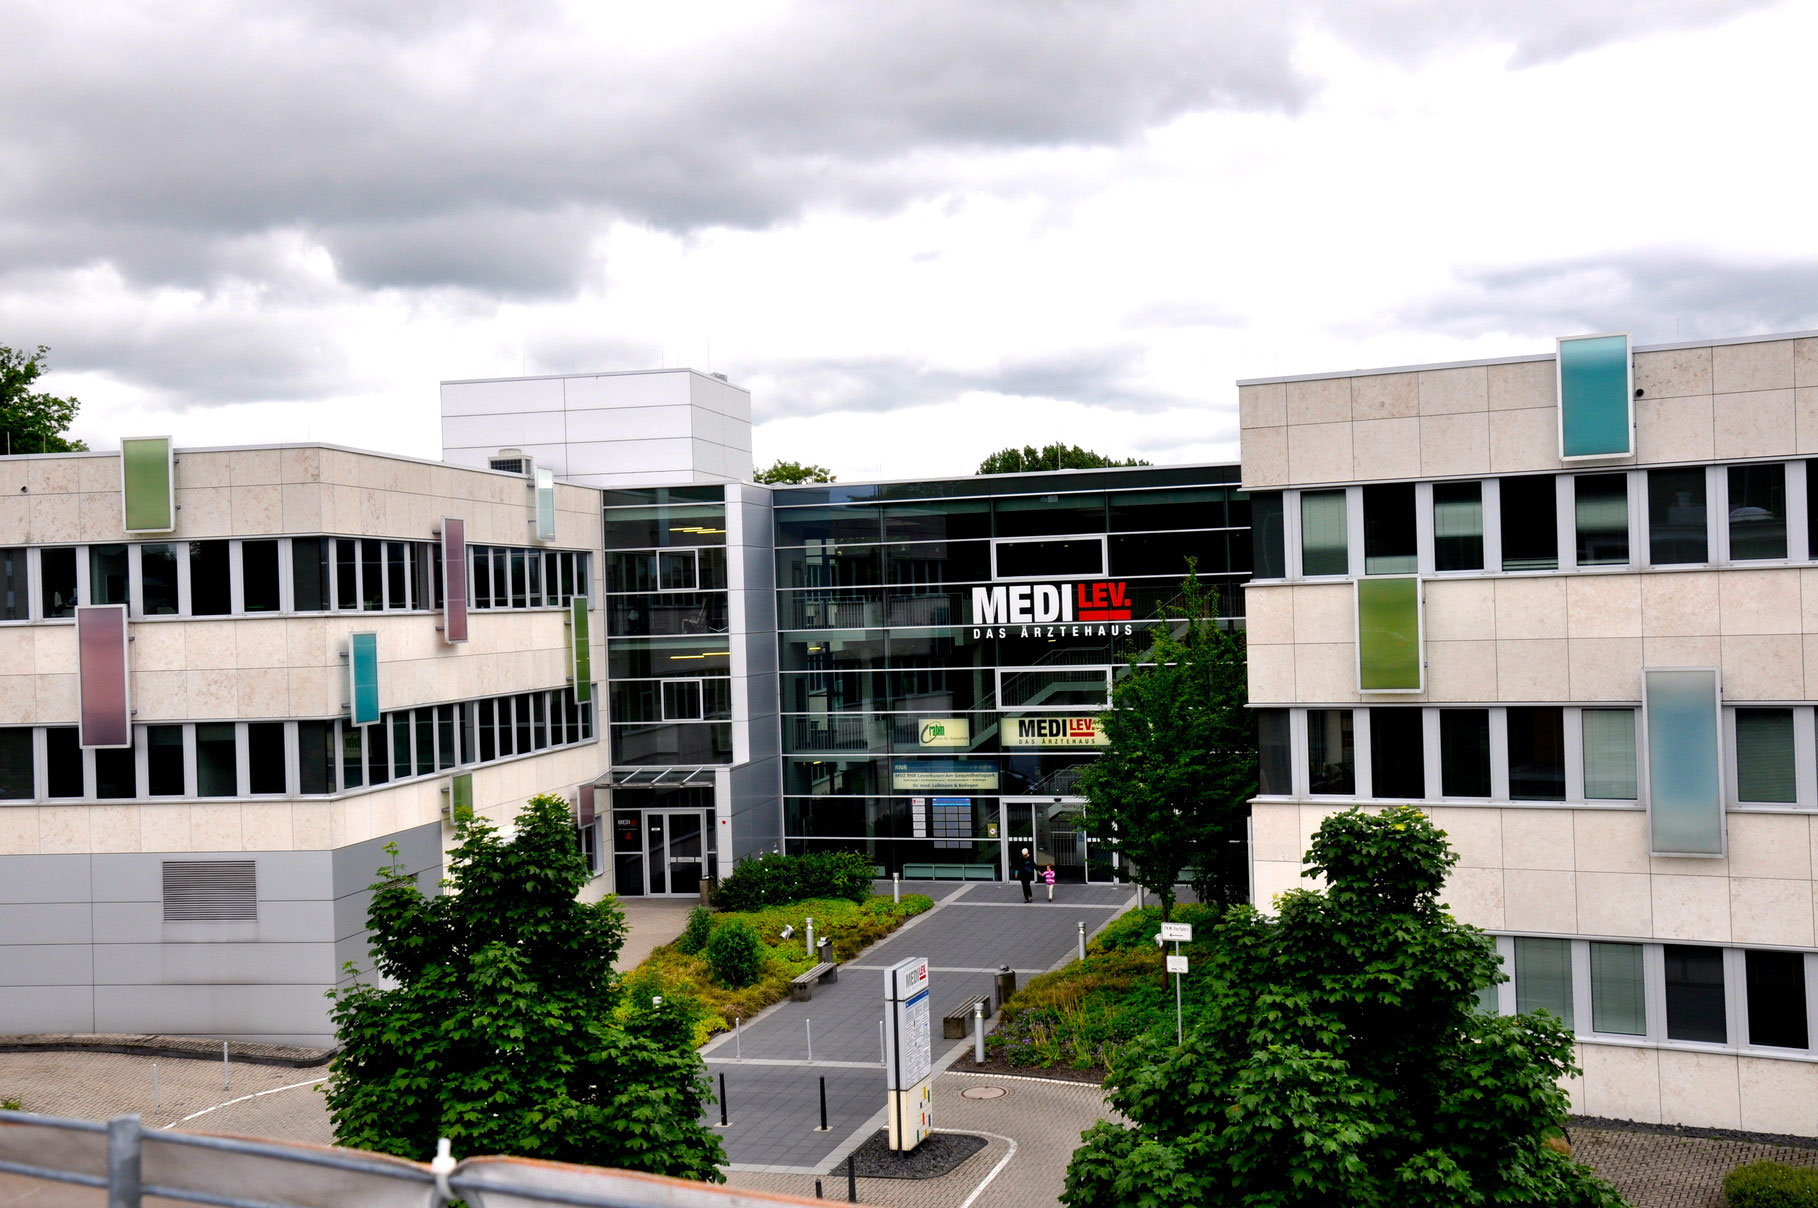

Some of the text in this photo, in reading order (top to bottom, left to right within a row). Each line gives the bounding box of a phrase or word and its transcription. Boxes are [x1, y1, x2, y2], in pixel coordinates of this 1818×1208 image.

[972, 582, 1131, 624] MEDI LEV.
[973, 625, 1132, 639] DAS ÄRZTEHAUS
[1018, 719, 1094, 737] MEDI LEV.
